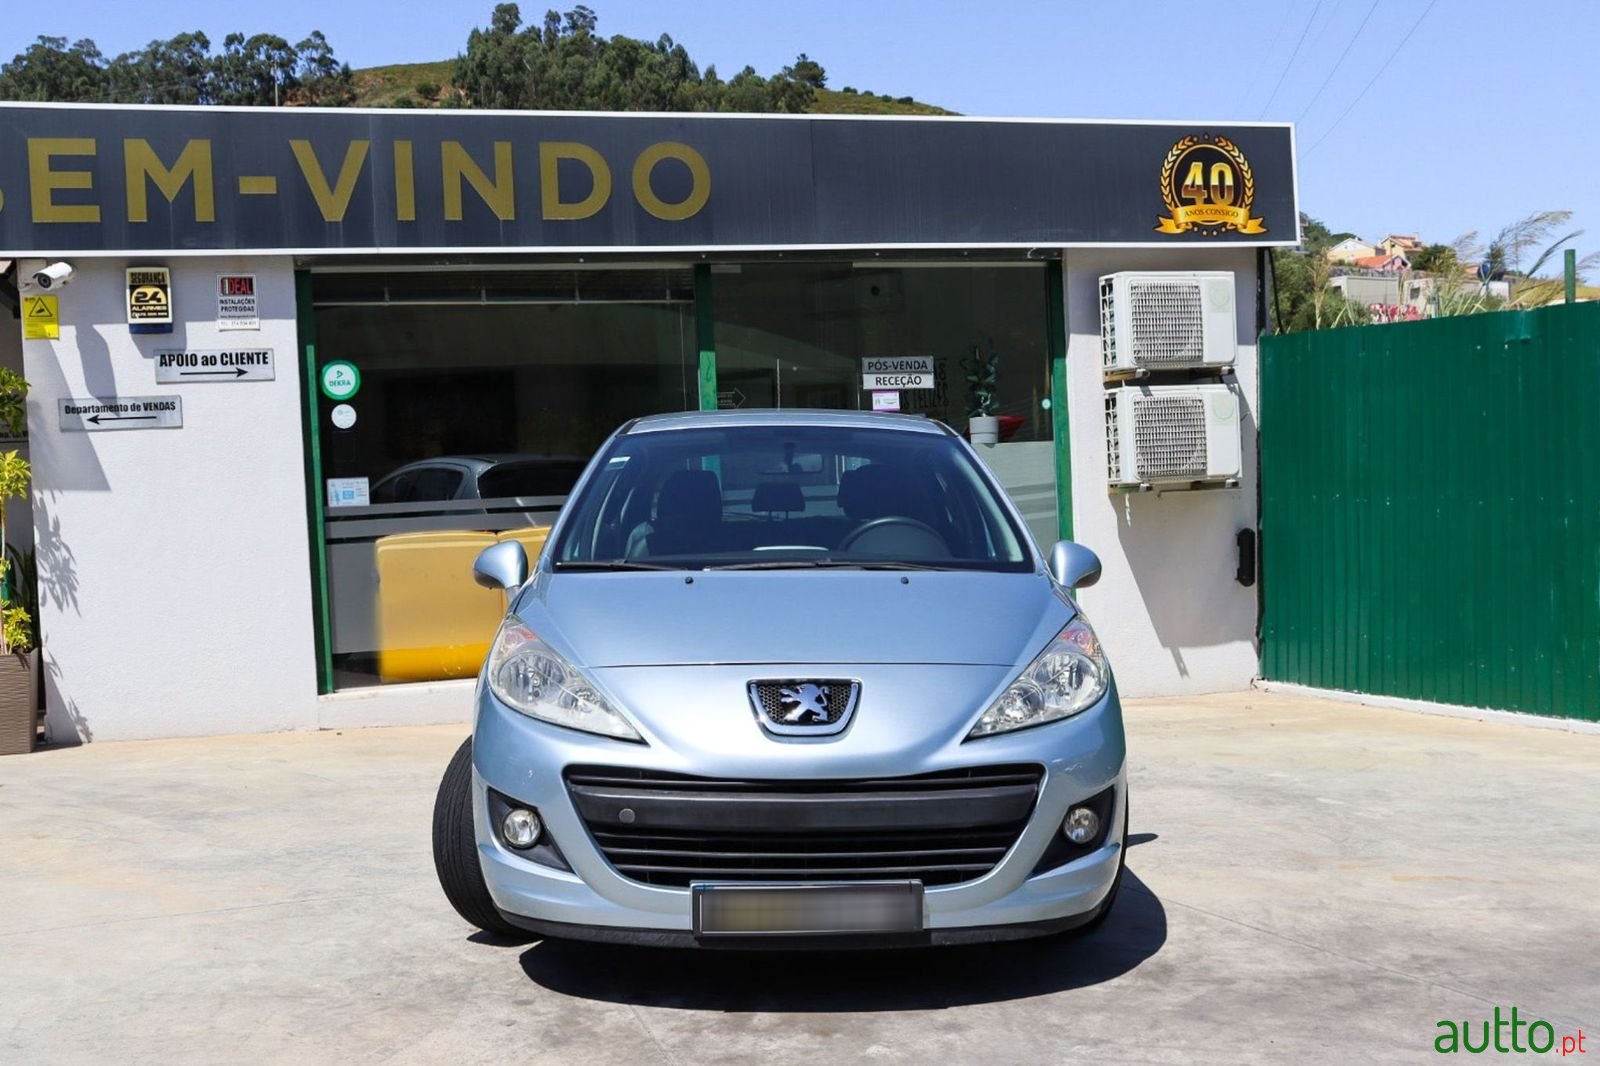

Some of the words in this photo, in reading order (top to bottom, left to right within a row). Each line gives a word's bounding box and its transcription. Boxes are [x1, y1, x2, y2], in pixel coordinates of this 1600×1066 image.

[0, 138, 711, 223] EM-VINDO
[1181, 161, 1234, 205] 40
[1185, 208, 1204, 217] ANOS
[1205, 208, 1239, 218] CONSIGO
[134, 291, 162, 303] 24
[159, 353, 197, 367] APOIO
[201, 354, 217, 367] ao
[220, 352, 269, 366] CLIENTE
[867, 359, 929, 371] PÓS-VENDA
[875, 373, 922, 388] RECEÇÃO
[64, 403, 129, 415] Departamento
[130, 402, 142, 412] de
[143, 401, 176, 411] VENDAS
